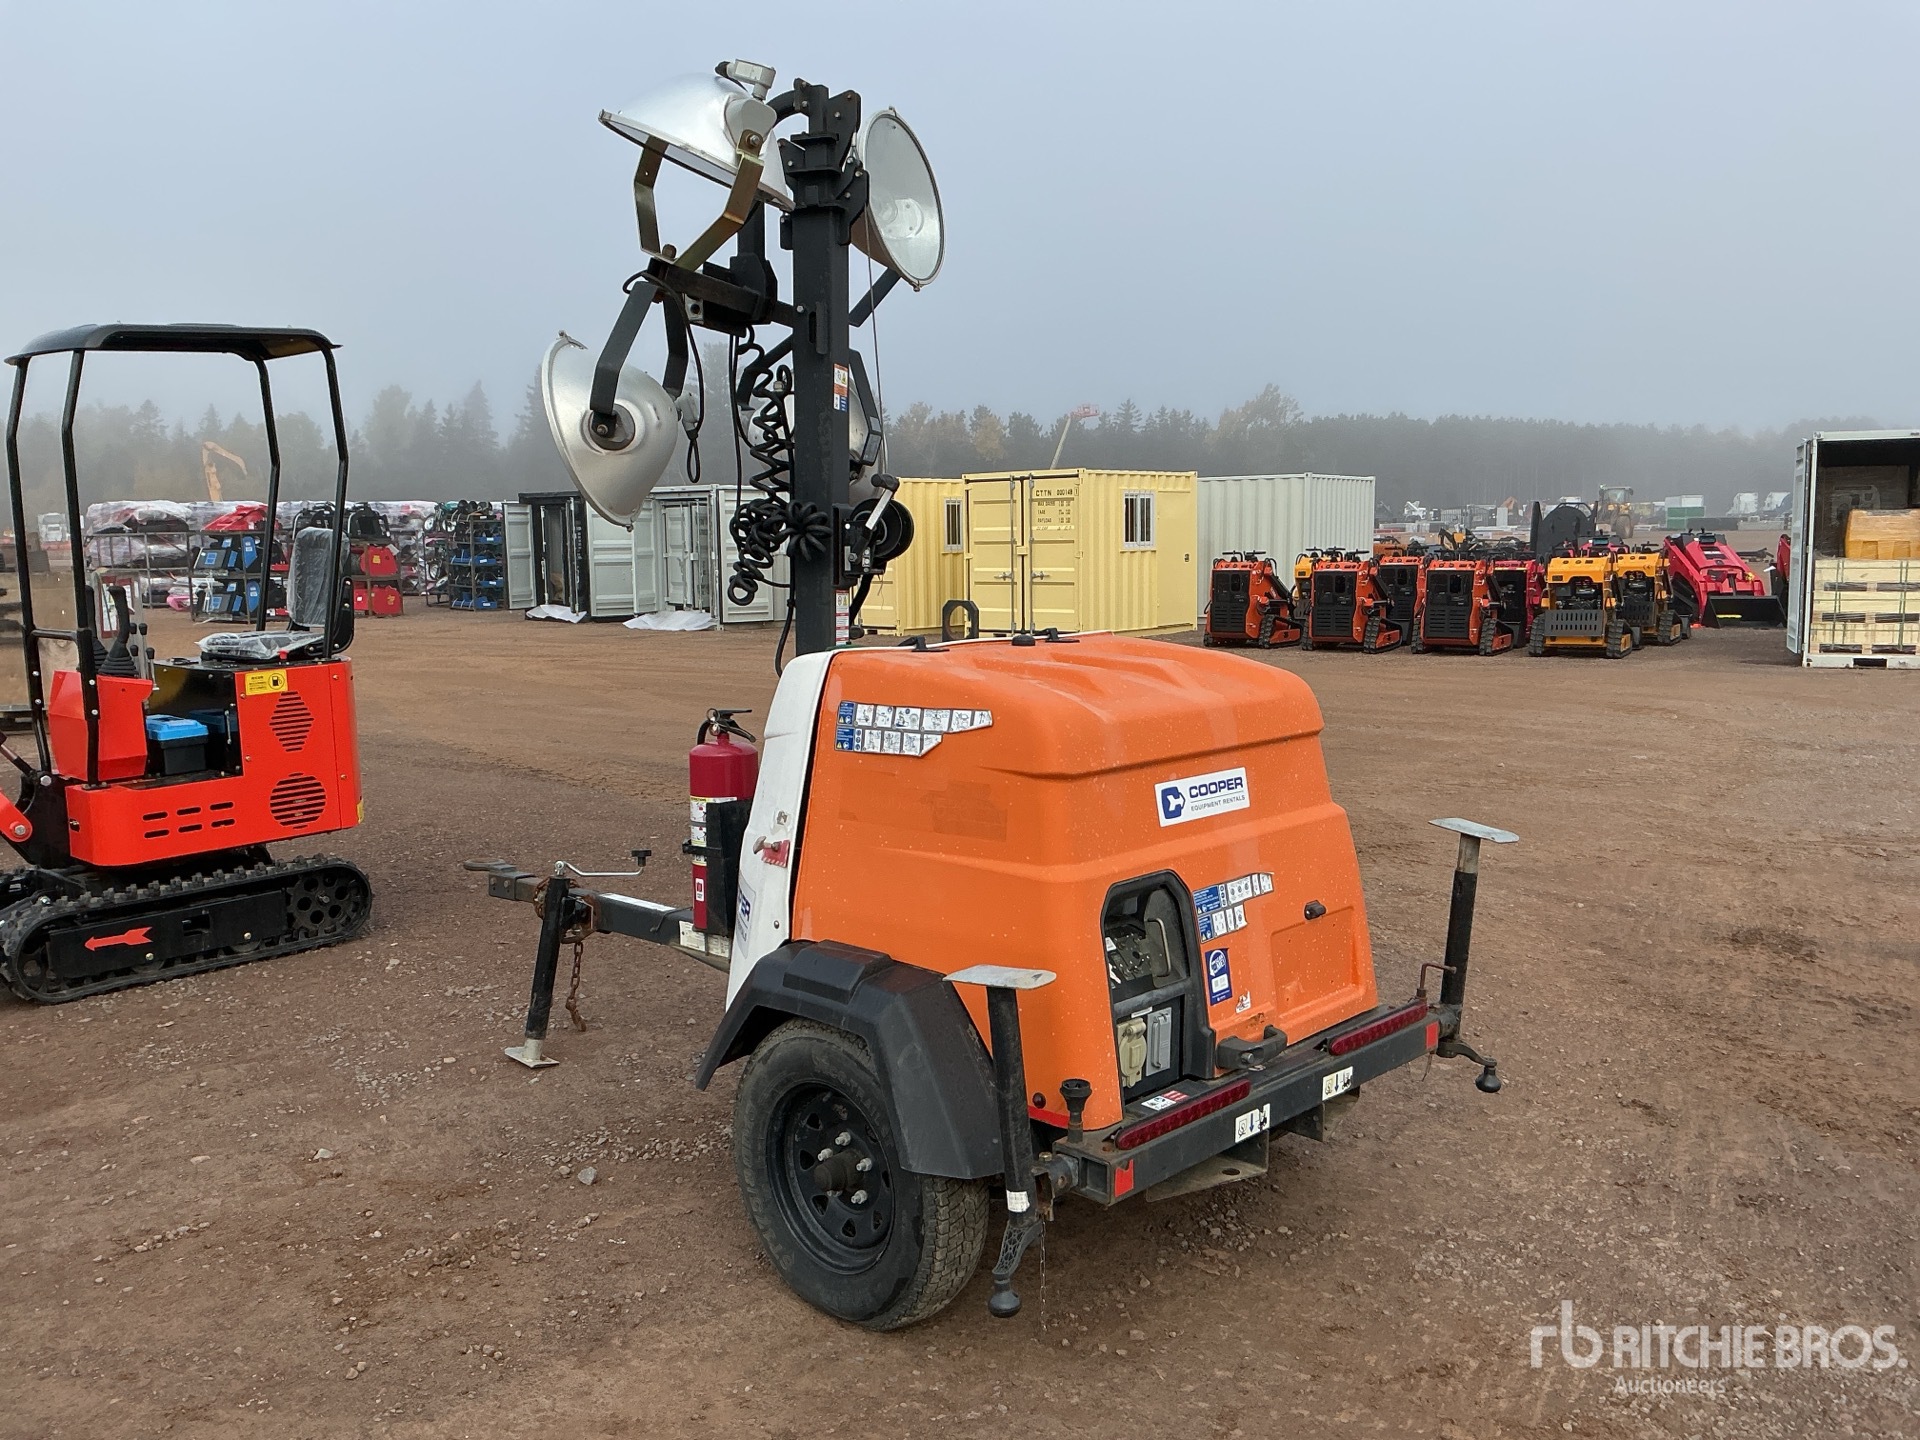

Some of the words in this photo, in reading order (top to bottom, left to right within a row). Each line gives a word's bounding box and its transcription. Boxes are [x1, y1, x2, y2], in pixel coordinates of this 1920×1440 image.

[1035, 489, 1052, 497] CTTN
[1189, 777, 1243, 798] COOPER
[1191, 801, 1221, 811] EQUIPMENT
[1222, 795, 1245, 804] RENTALS
